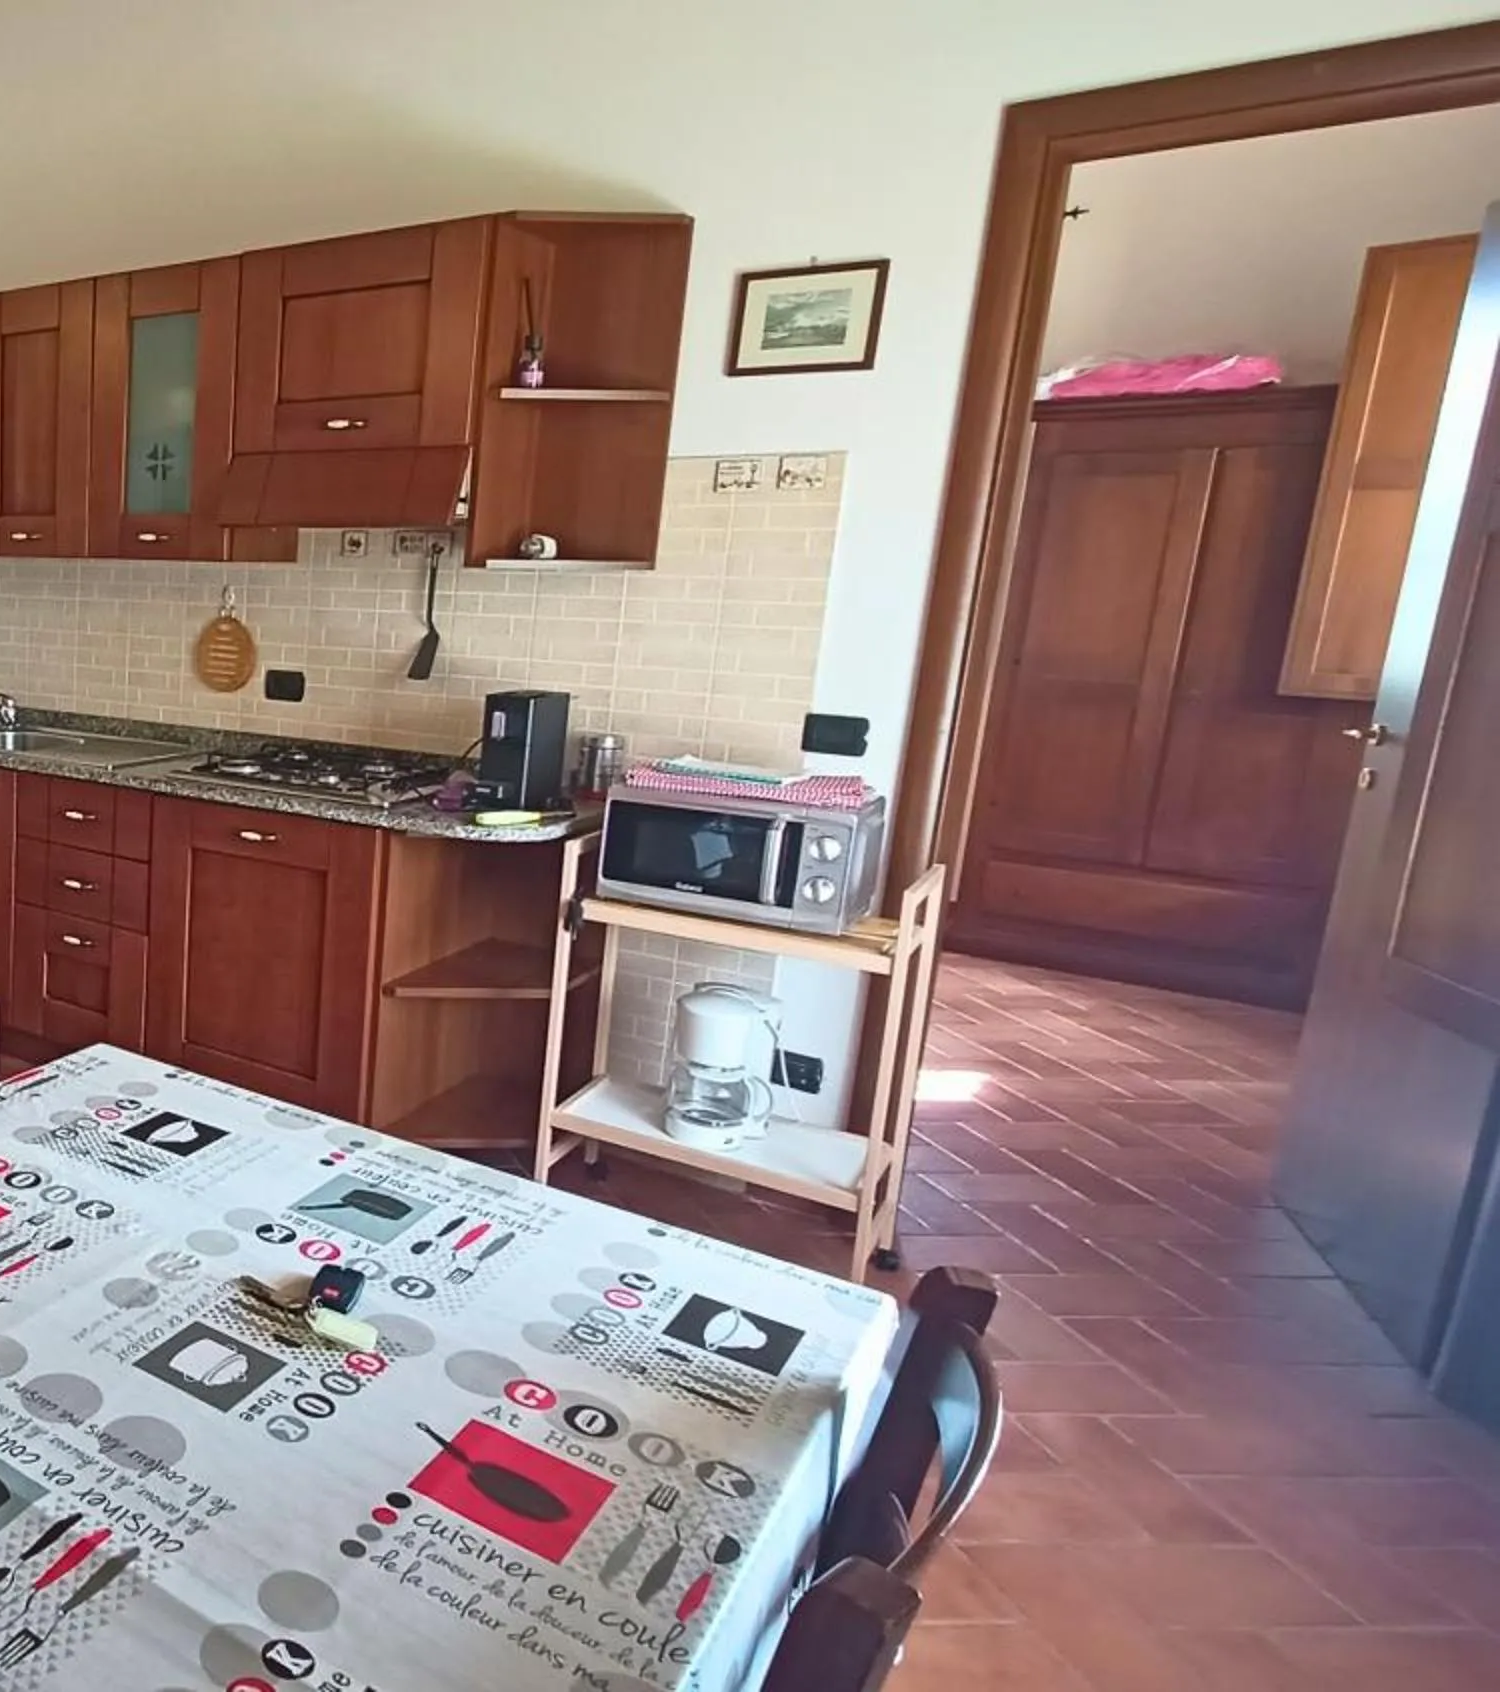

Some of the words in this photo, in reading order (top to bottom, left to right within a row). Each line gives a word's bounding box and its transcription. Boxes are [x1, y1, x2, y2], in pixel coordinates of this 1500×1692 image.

[285, 1367, 311, 1387] At
[239, 1388, 289, 1422] Home
[266, 1351, 389, 1442] COOK
[58, 1407, 87, 1428] ma
[83, 1422, 128, 1453] dans
[482, 1405, 523, 1429] At
[544, 1430, 627, 1477] Home
[503, 1378, 757, 1499] COOK
[43, 1462, 75, 1487] en
[128, 1448, 188, 1485] couleur
[188, 1479, 212, 1506] la
[206, 1492, 237, 1518] de
[72, 1487, 185, 1553] cuisiner
[413, 1513, 544, 1583] cuisiner
[548, 1582, 587, 1613] en
[599, 1610, 691, 1665] coule
[370, 1551, 398, 1573] de
[399, 1561, 422, 1587] la
[428, 1585, 506, 1631] couleur
[508, 1626, 566, 1670] dans
[572, 1663, 609, 1692] ma
[507, 1590, 527, 1609] la
[609, 1649, 634, 1668] de
[639, 1659, 661, 1681] la
